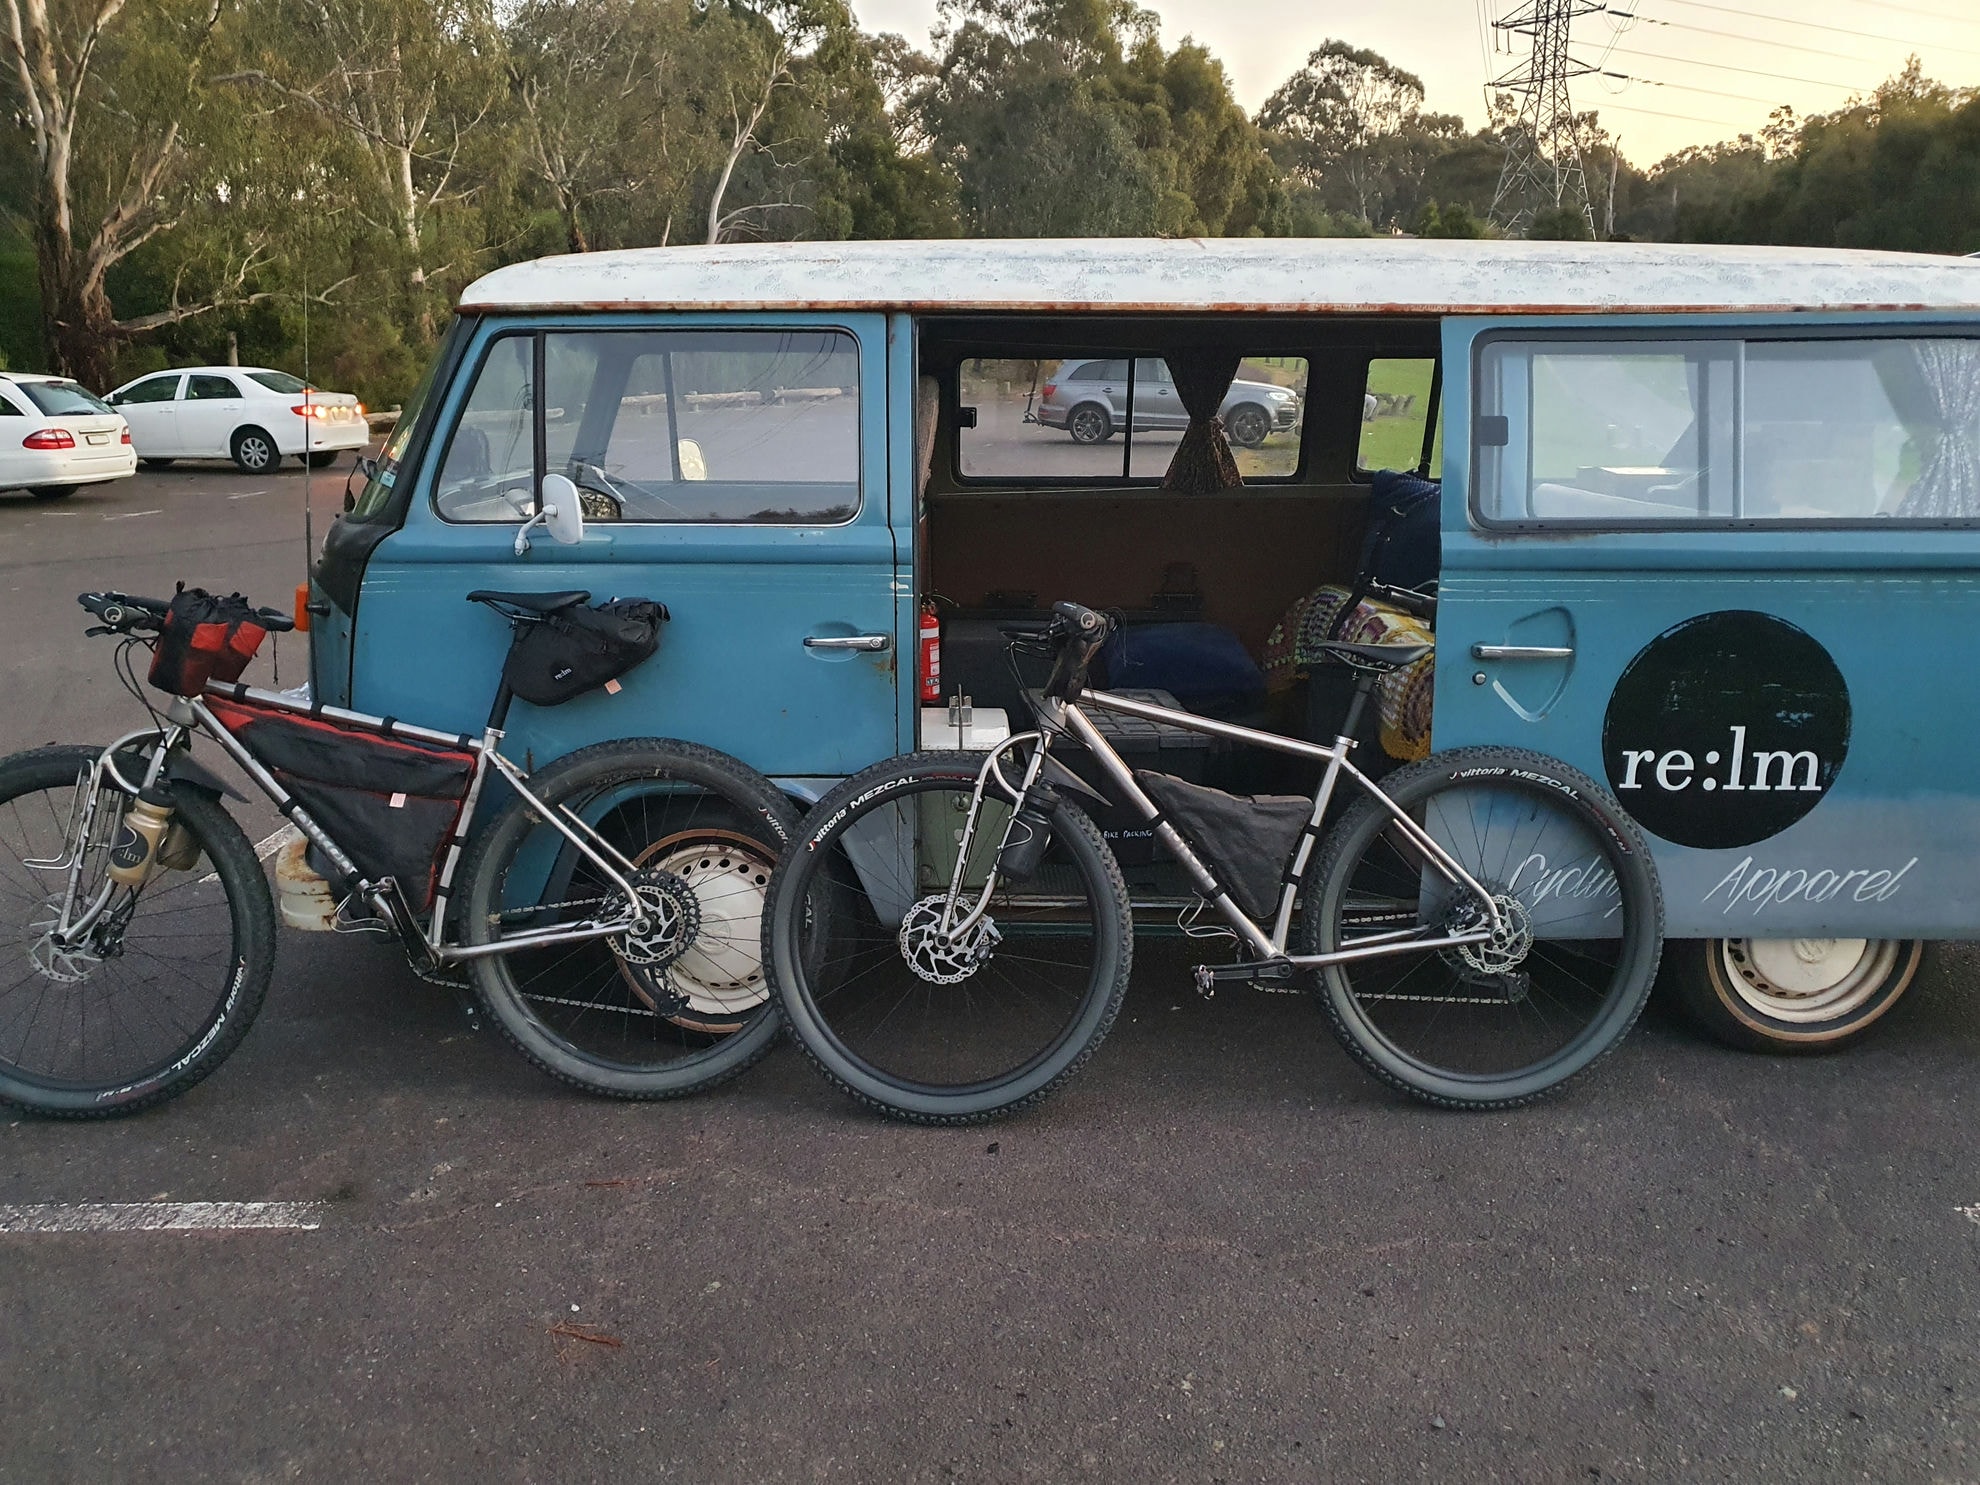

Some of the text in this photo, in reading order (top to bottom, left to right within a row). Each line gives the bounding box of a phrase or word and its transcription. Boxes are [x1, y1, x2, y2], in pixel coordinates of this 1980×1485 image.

[1460, 766, 1580, 801] vittoria MEZCAL
[1618, 725, 1823, 792] re:lm
[765, 813, 789, 845] vittor
[813, 775, 920, 843] vittoria MEZCAL
[1123, 829, 1153, 839] PACKING
[1507, 853, 1919, 919] Cyclin Apparel
[171, 1012, 226, 1071] MEZCAL
